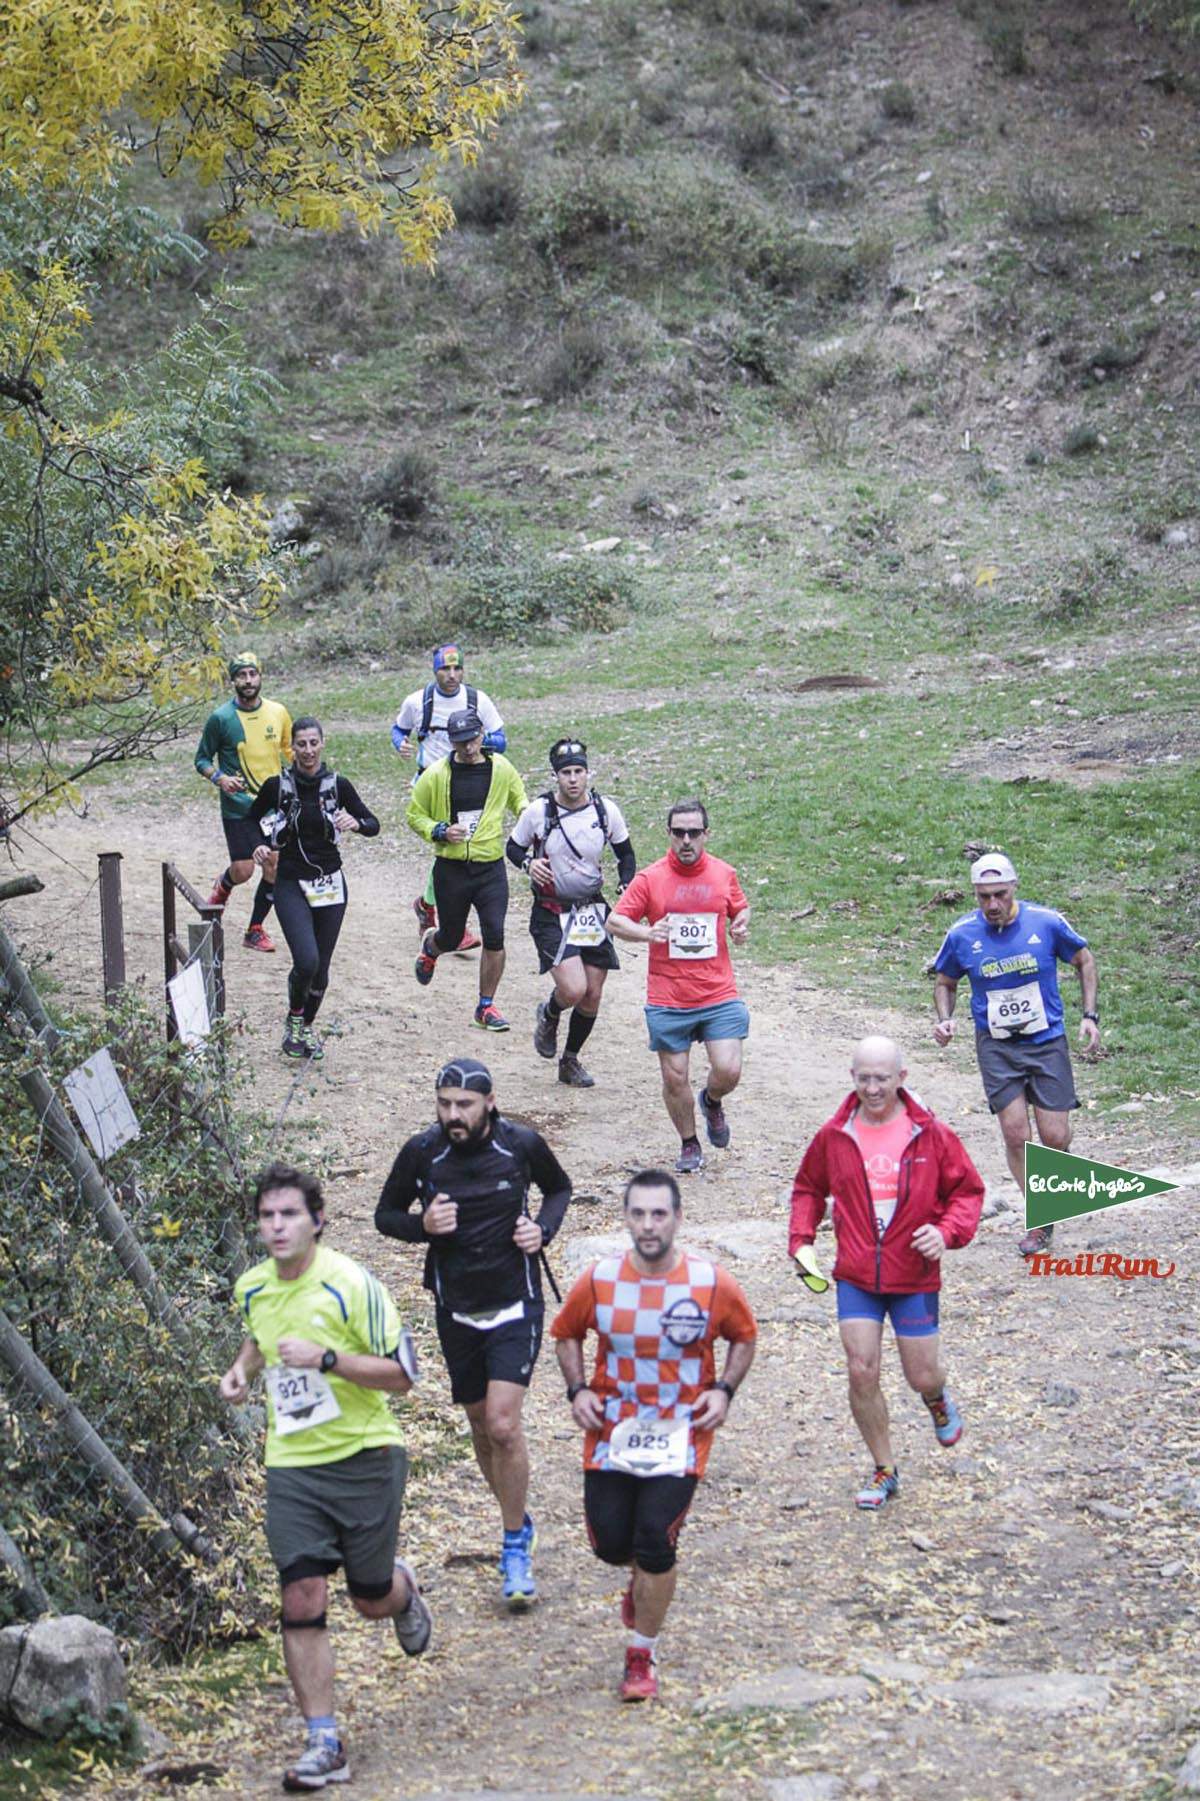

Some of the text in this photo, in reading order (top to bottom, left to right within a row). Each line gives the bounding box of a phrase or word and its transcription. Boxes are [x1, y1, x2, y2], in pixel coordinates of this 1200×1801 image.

[680, 925, 707, 938] 807
[999, 1000, 1031, 1017] 692
[278, 1375, 308, 1399] 927
[628, 1434, 669, 1450] 825
